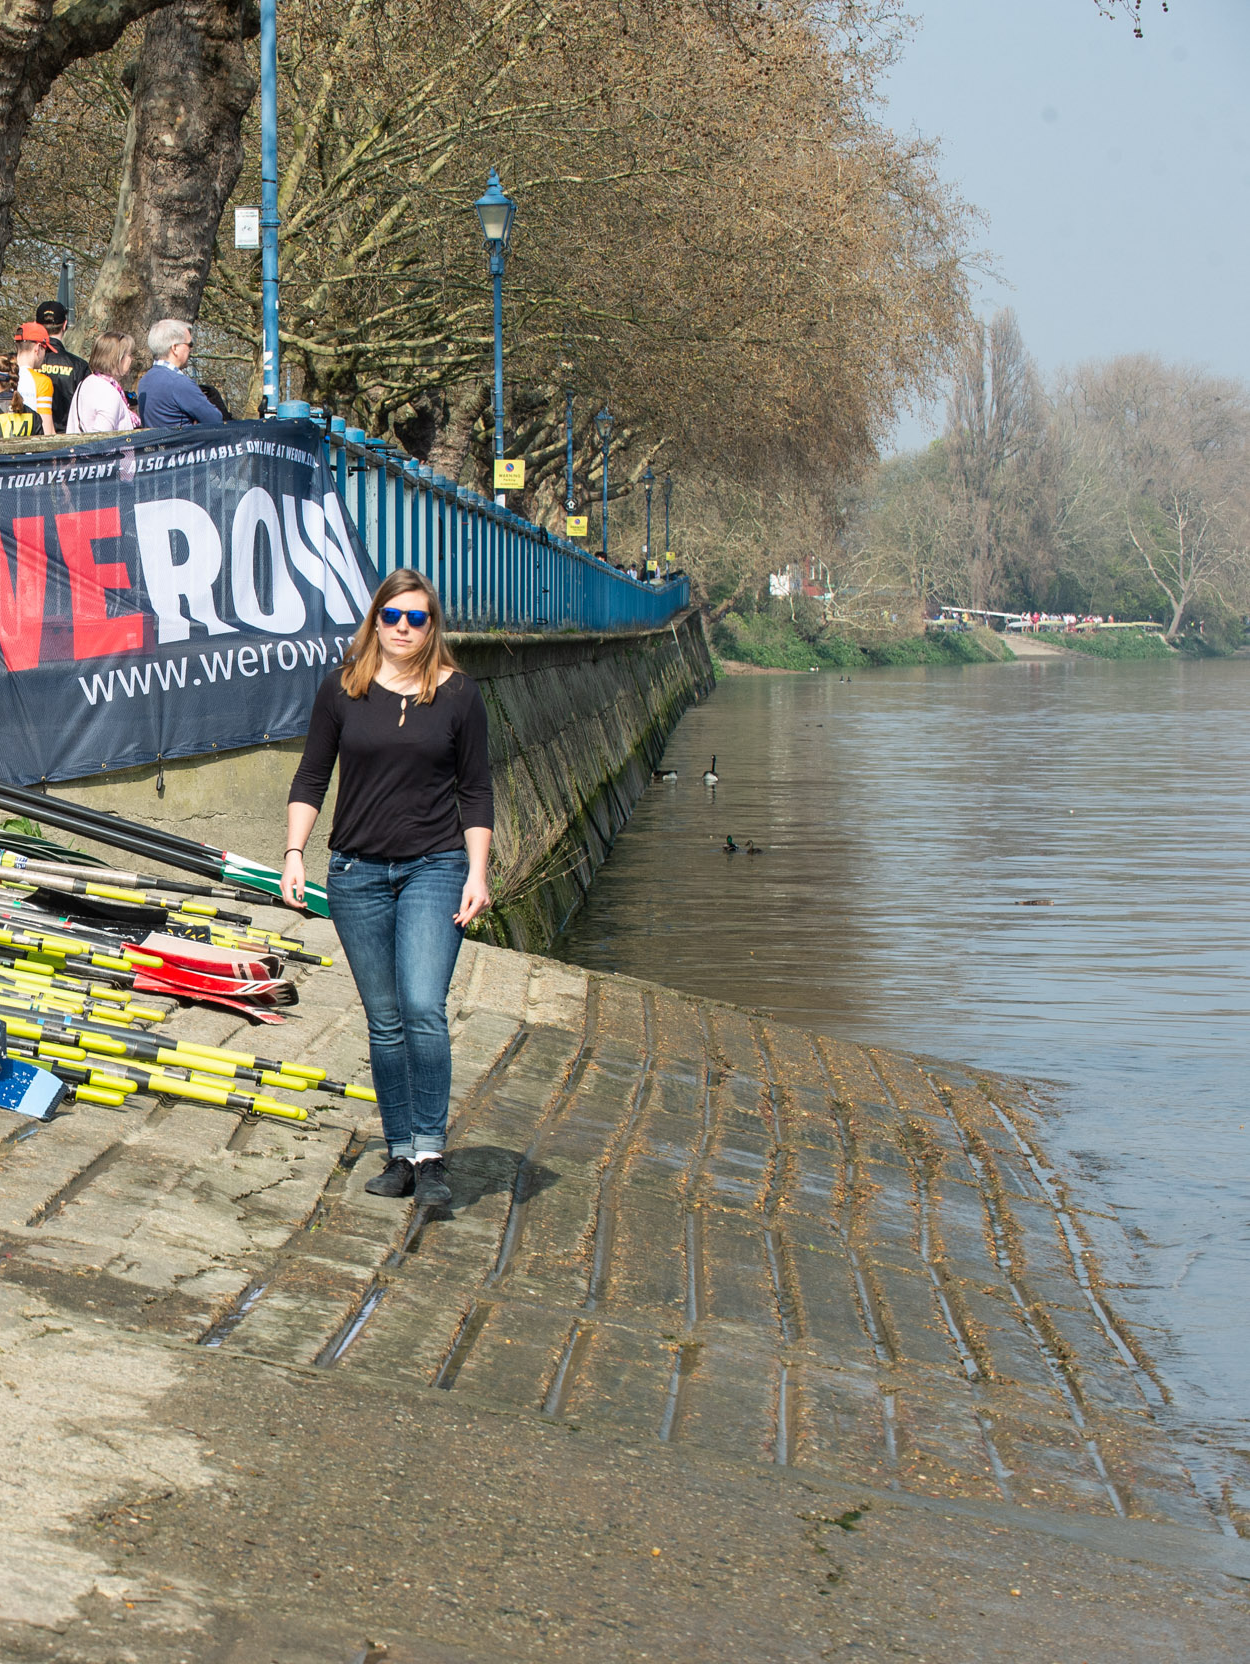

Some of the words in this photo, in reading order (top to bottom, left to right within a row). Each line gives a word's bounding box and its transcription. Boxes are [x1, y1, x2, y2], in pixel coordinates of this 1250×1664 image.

[7, 471, 65, 489] TODAYS
[68, 463, 119, 482] EVENT
[128, 456, 165, 475] ALSO
[167, 443, 244, 469] AVAILABLE
[246, 440, 275, 457] ONLINE
[276, 444, 286, 457] AT
